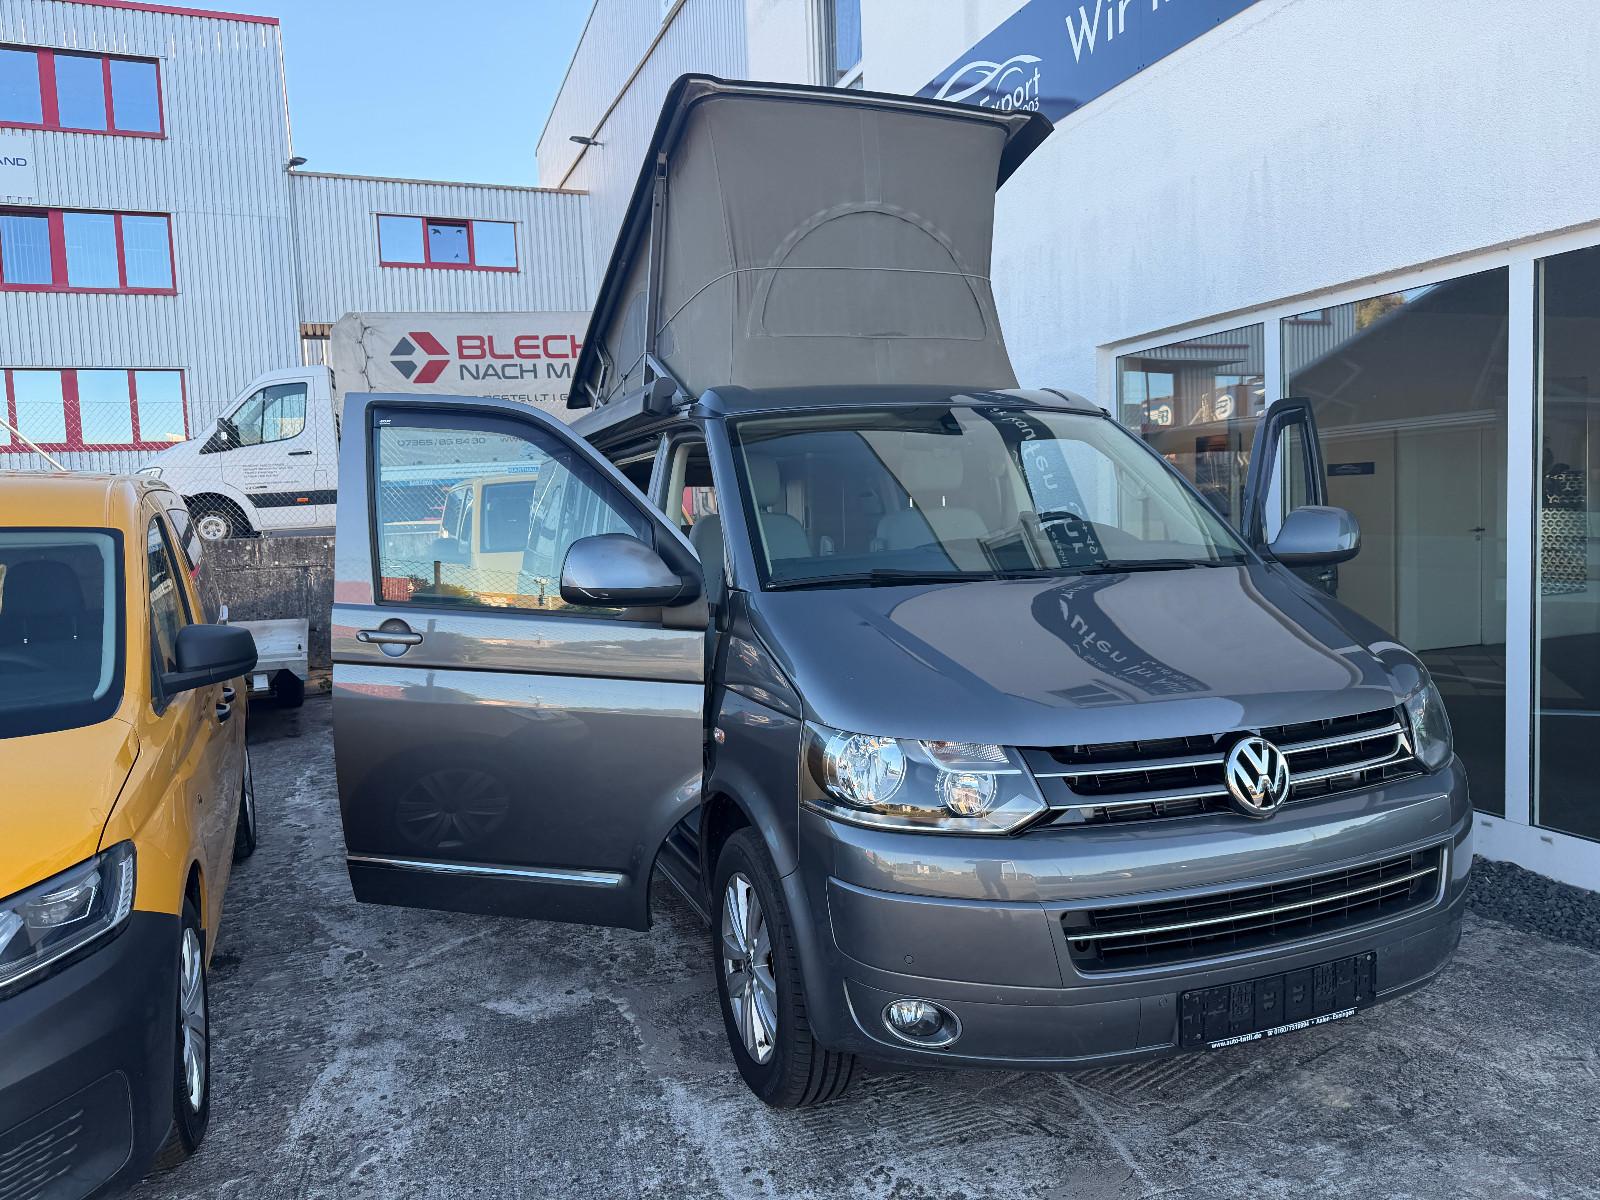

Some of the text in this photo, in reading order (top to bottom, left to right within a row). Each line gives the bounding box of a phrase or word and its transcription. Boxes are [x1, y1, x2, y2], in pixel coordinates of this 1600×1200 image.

[1065, 0, 1131, 64] Wir
[460, 363, 537, 380] NACH
[1227, 737, 1289, 810] VW
